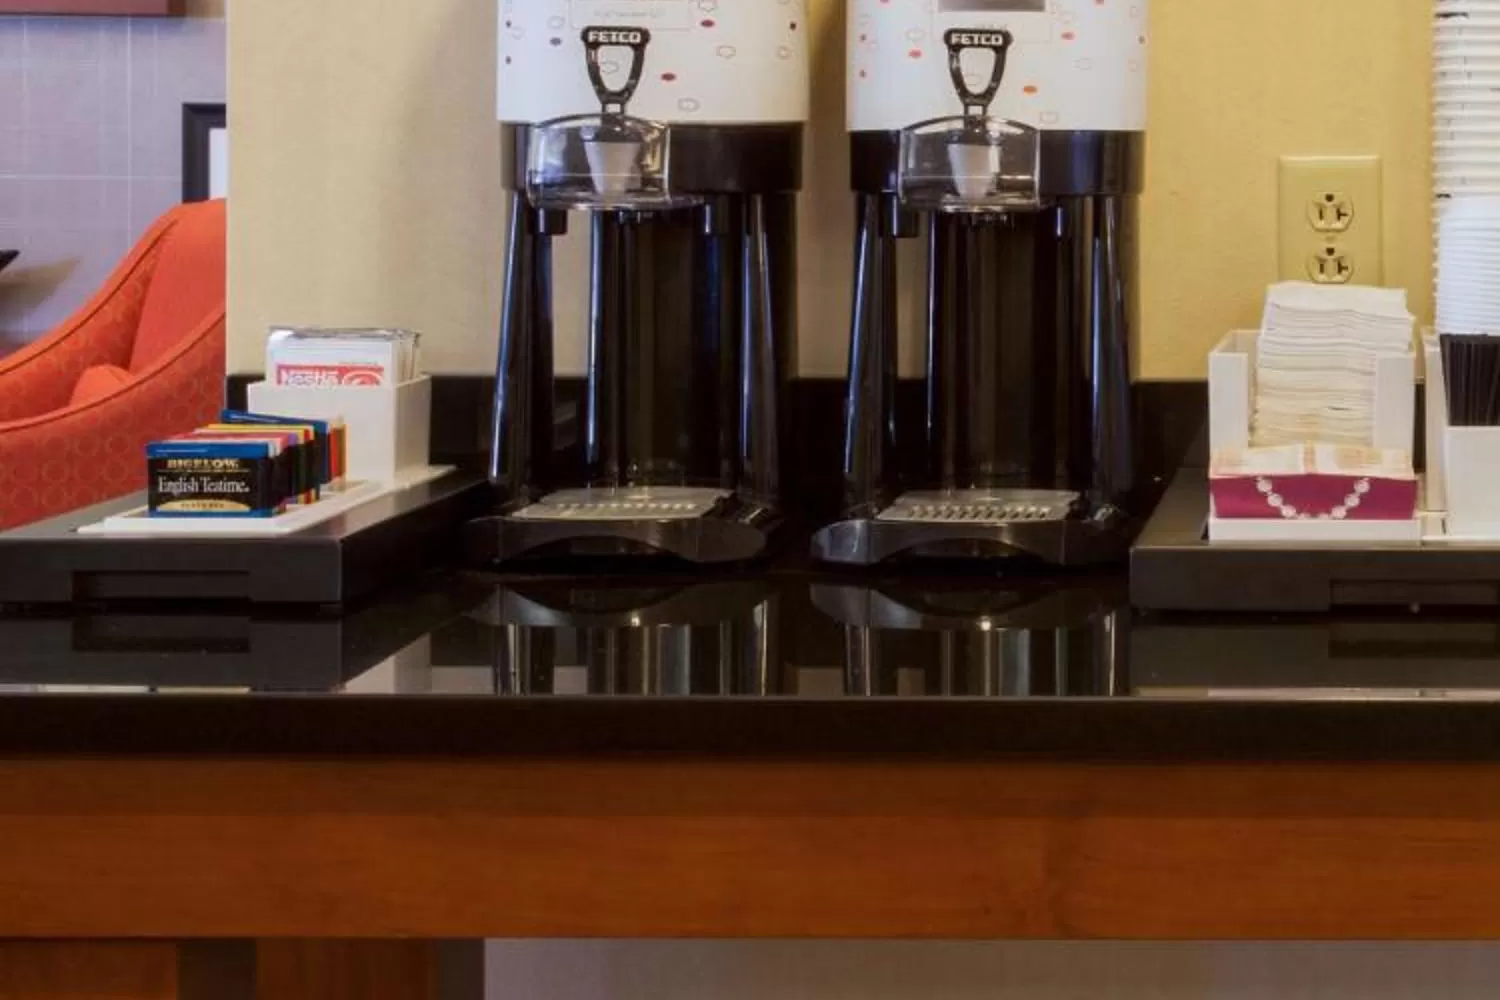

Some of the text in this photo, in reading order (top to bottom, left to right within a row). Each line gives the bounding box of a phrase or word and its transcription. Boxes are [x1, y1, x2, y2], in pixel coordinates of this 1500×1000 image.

[587, 30, 642, 43] FETCO
[951, 33, 1004, 46] FETCO
[157, 476, 200, 496] English
